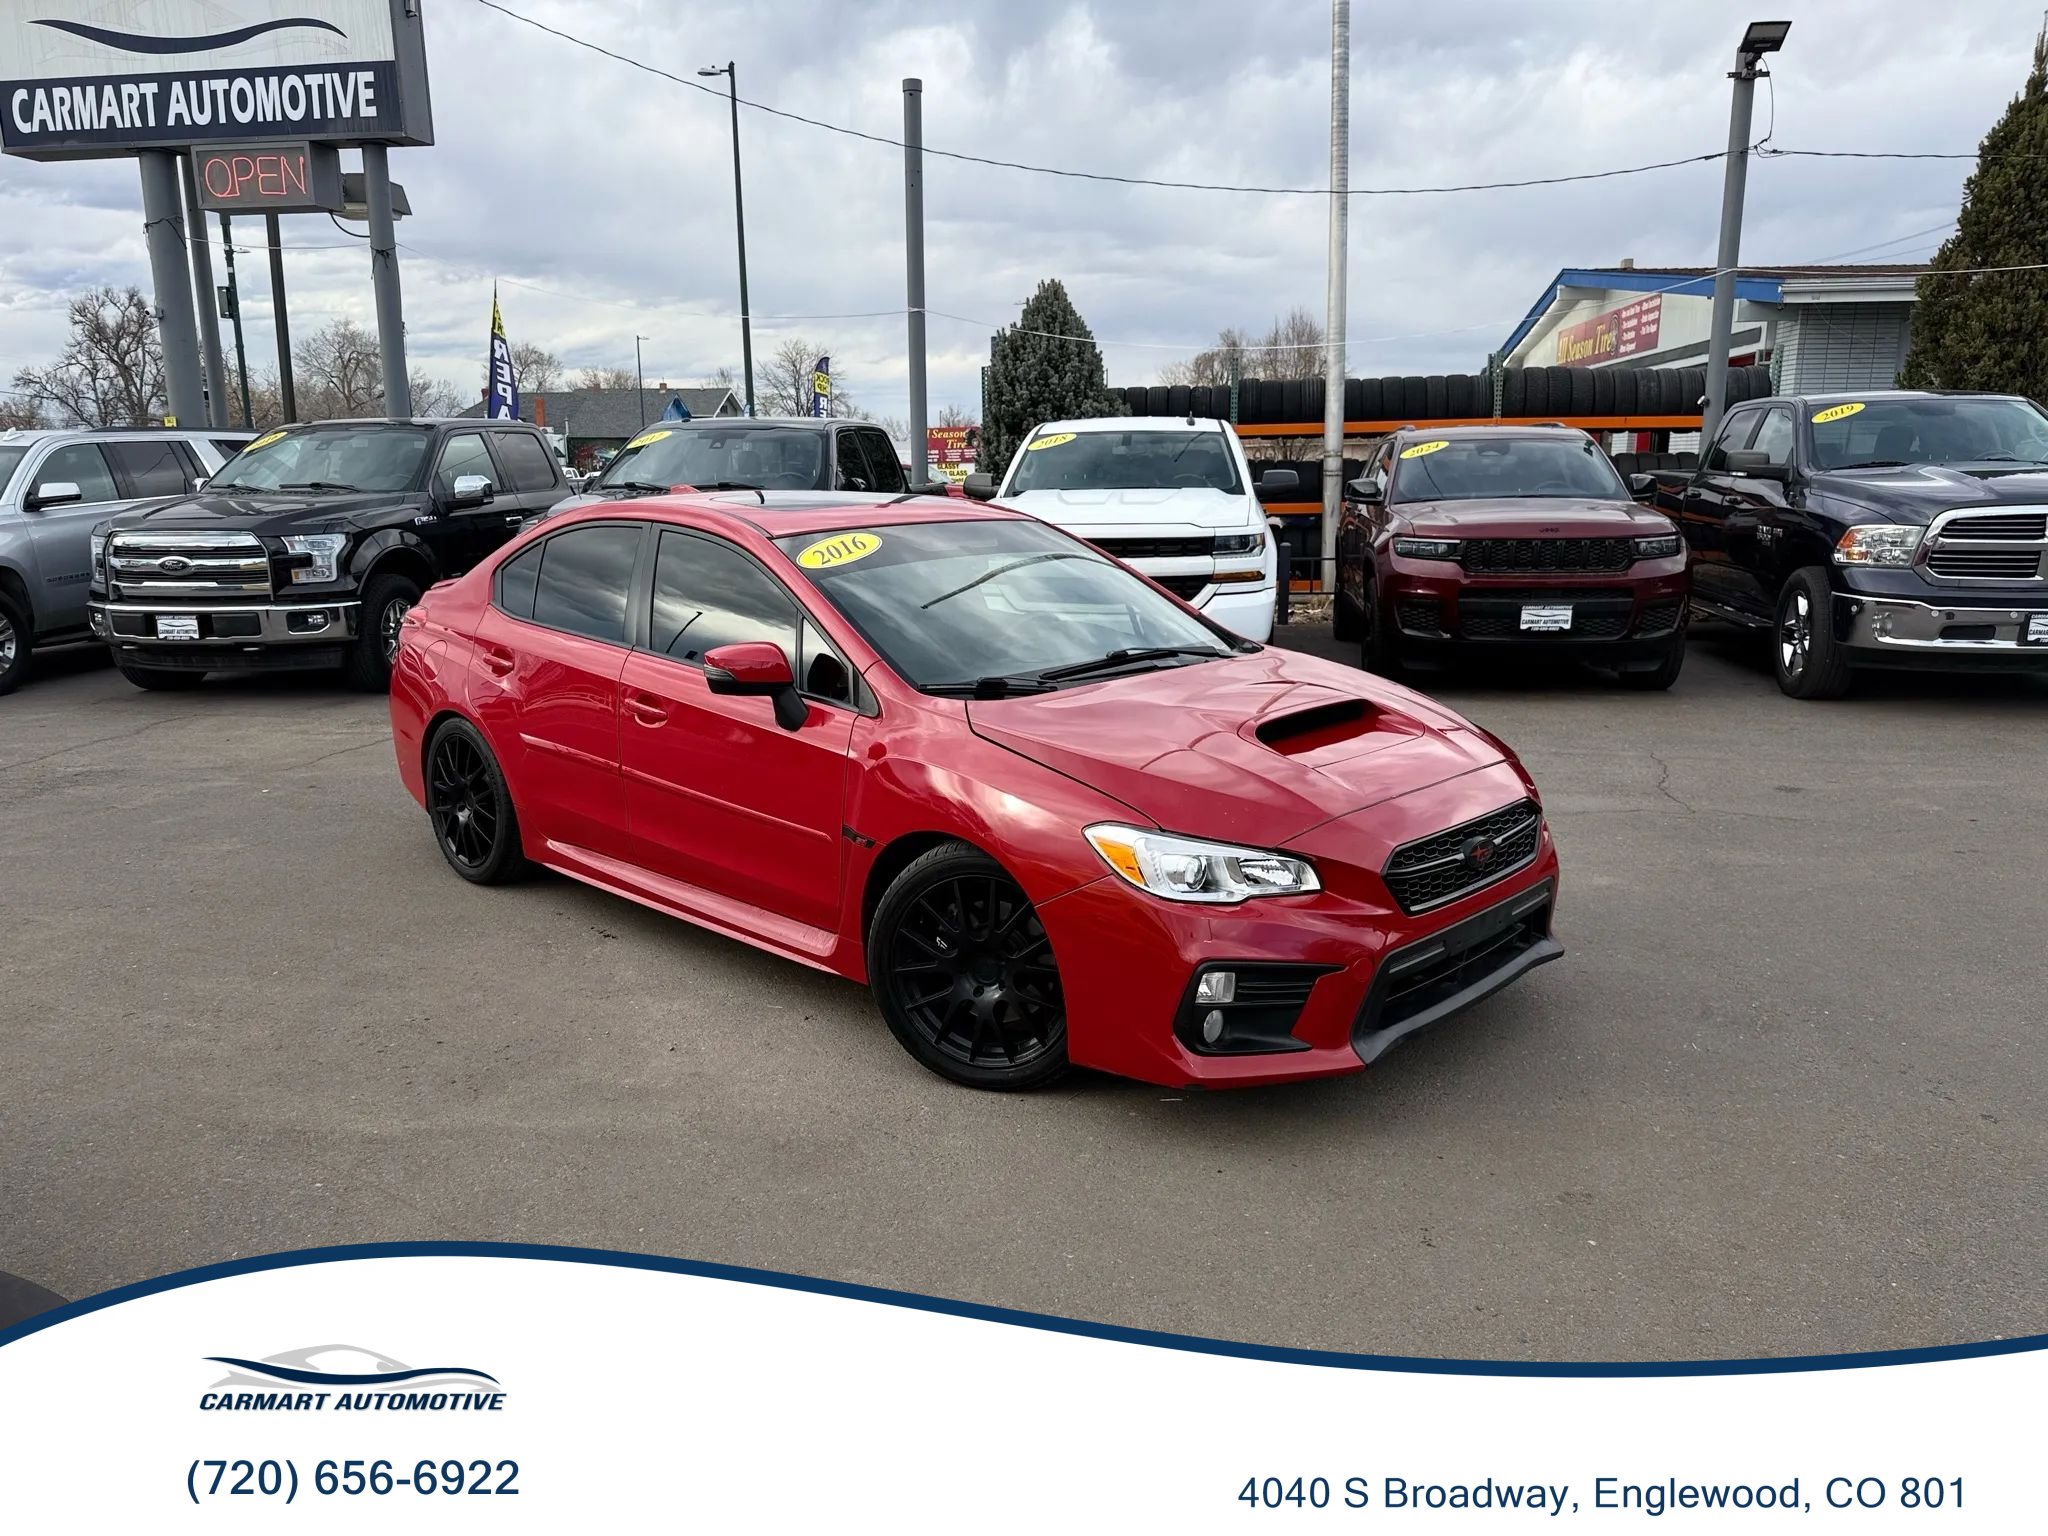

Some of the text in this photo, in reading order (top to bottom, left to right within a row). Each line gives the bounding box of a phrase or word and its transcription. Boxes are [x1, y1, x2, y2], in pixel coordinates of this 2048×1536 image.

[12, 71, 378, 134] CARMART AUTOMOTIVE
[204, 155, 306, 198] OPEN
[1567, 335, 1594, 362] Season
[1823, 405, 1854, 421] 2019
[931, 429, 967, 439] Season
[1035, 434, 1069, 449] 2018
[946, 439, 967, 449] Tire
[1410, 442, 1440, 457] 2024
[812, 535, 867, 565] 2016
[163, 560, 184, 570] Ford
